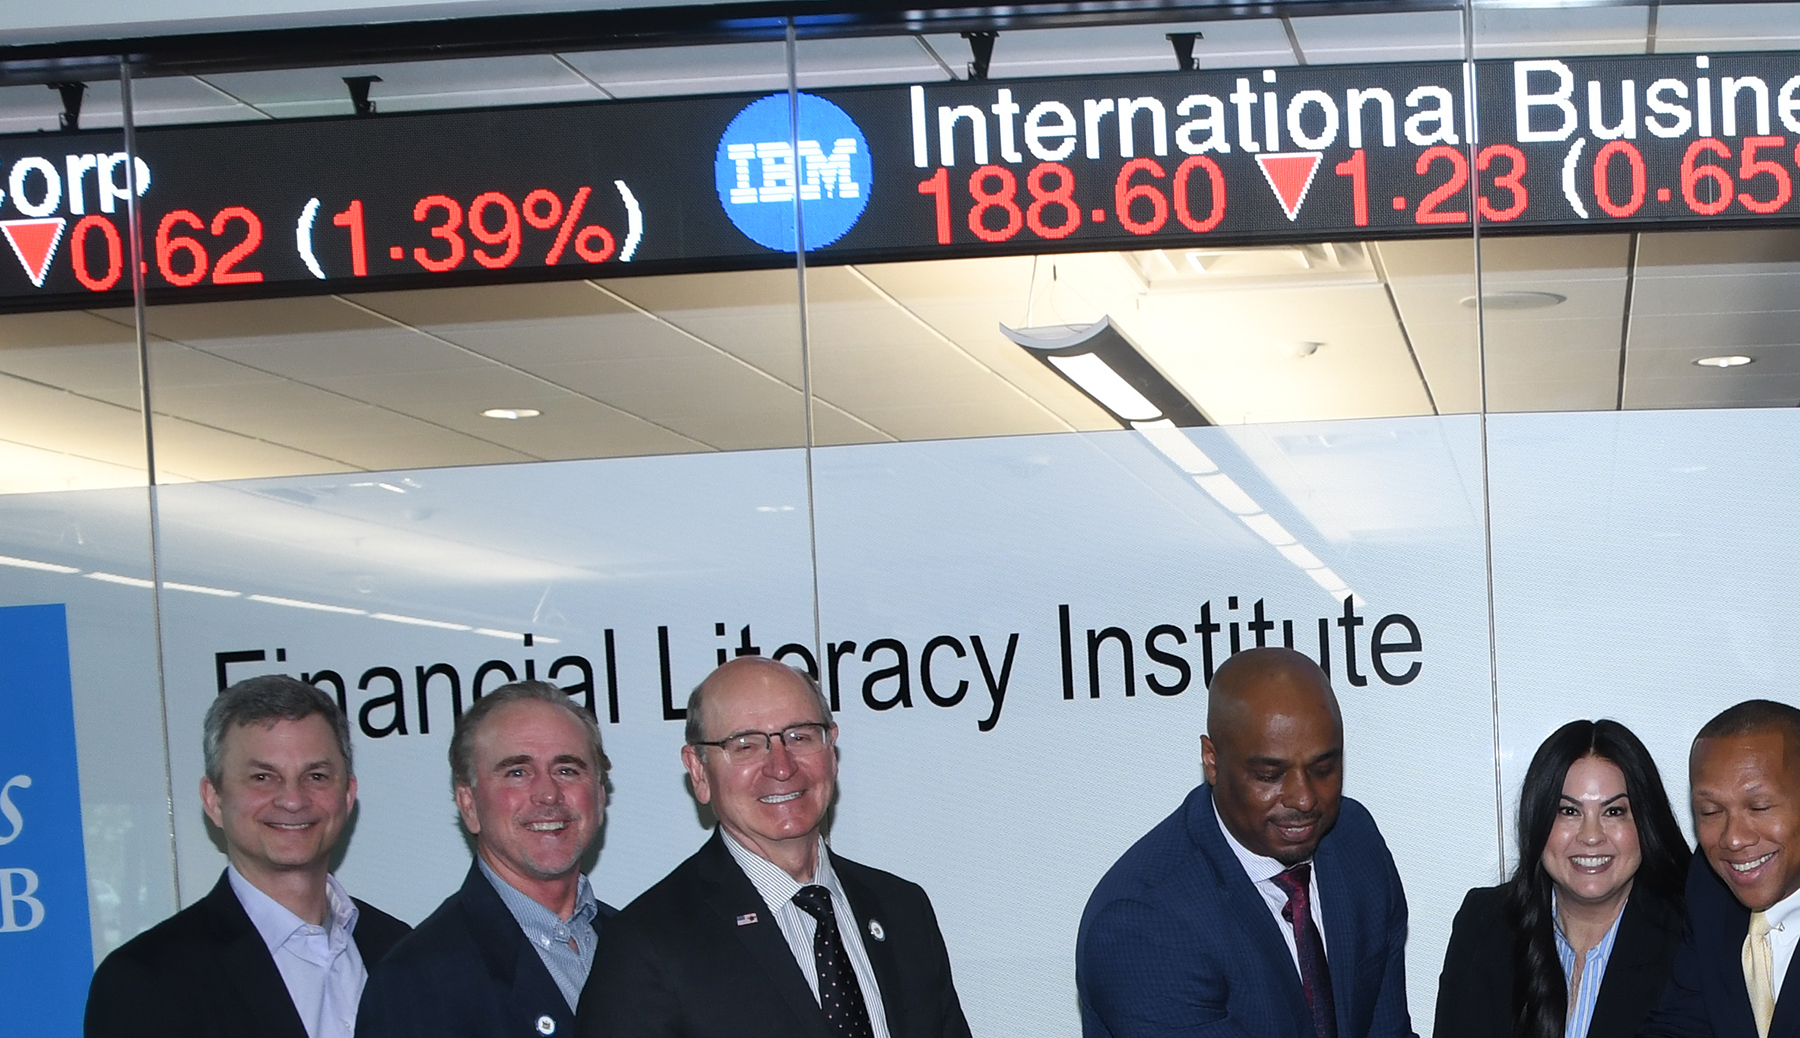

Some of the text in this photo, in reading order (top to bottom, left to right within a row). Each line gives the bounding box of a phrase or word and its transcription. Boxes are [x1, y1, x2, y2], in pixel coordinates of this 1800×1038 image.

[910, 70, 1478, 167] International
[0, 153, 151, 218] orp
[728, 138, 860, 205] IBM
[918, 155, 1227, 245] 188.60
[1336, 144, 1528, 226] 1.23
[297, 181, 643, 279] (1.39%)
[215, 628, 620, 738] Fnancal
[1058, 593, 1424, 700] Institute
